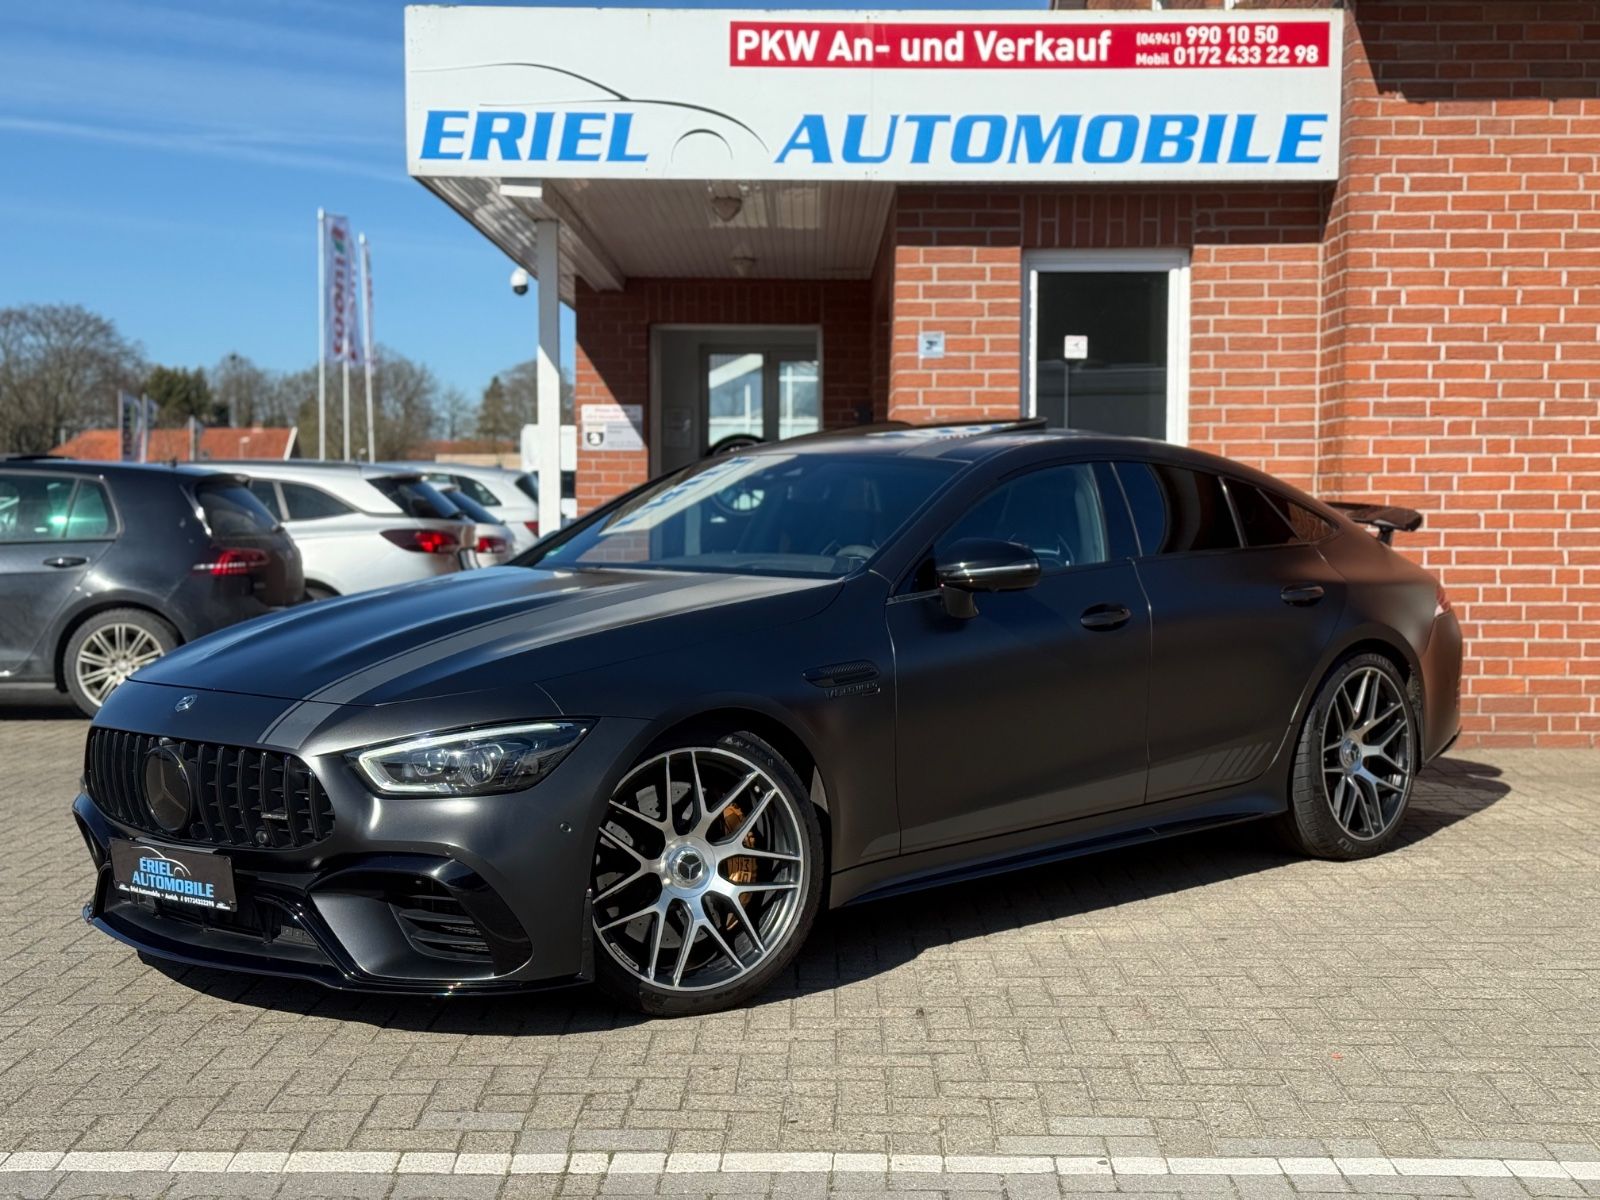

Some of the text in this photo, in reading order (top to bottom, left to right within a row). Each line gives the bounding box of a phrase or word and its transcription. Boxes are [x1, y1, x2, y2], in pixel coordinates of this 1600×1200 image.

[737, 29, 1112, 62] PKW An- und Verkauf
[1136, 25, 1278, 46] (04941) 990 10 50
[1135, 45, 1319, 66] Mobil 0172 433 22 98
[419, 110, 649, 163] ERIEL
[774, 113, 1328, 164] AUTOMOBILE
[139, 858, 174, 877] ERIEL
[132, 871, 214, 897] AUTOMOBILE
